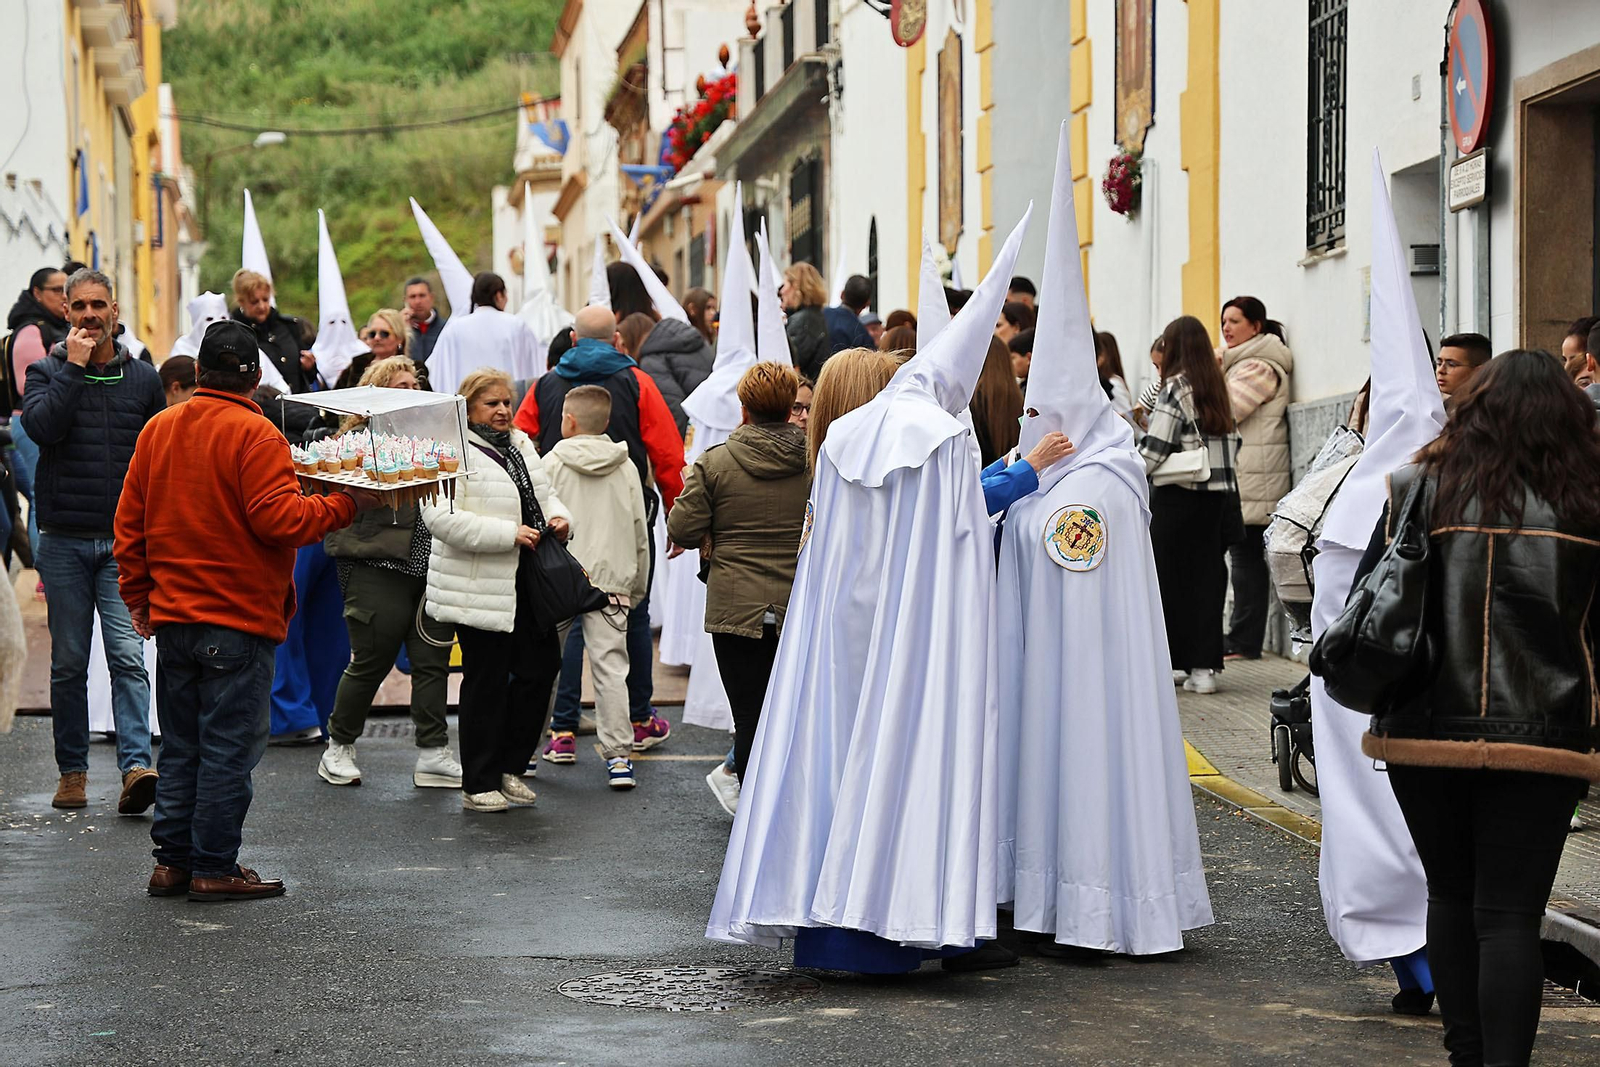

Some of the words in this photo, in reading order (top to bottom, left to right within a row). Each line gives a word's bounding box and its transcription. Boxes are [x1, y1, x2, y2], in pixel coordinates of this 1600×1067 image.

[1470, 157, 1482, 169] HORAS
[1450, 175, 1466, 189] EXCEPTO
[1466, 168, 1485, 184] SERVICIOS
[1453, 182, 1480, 198] PARROQUIALES
